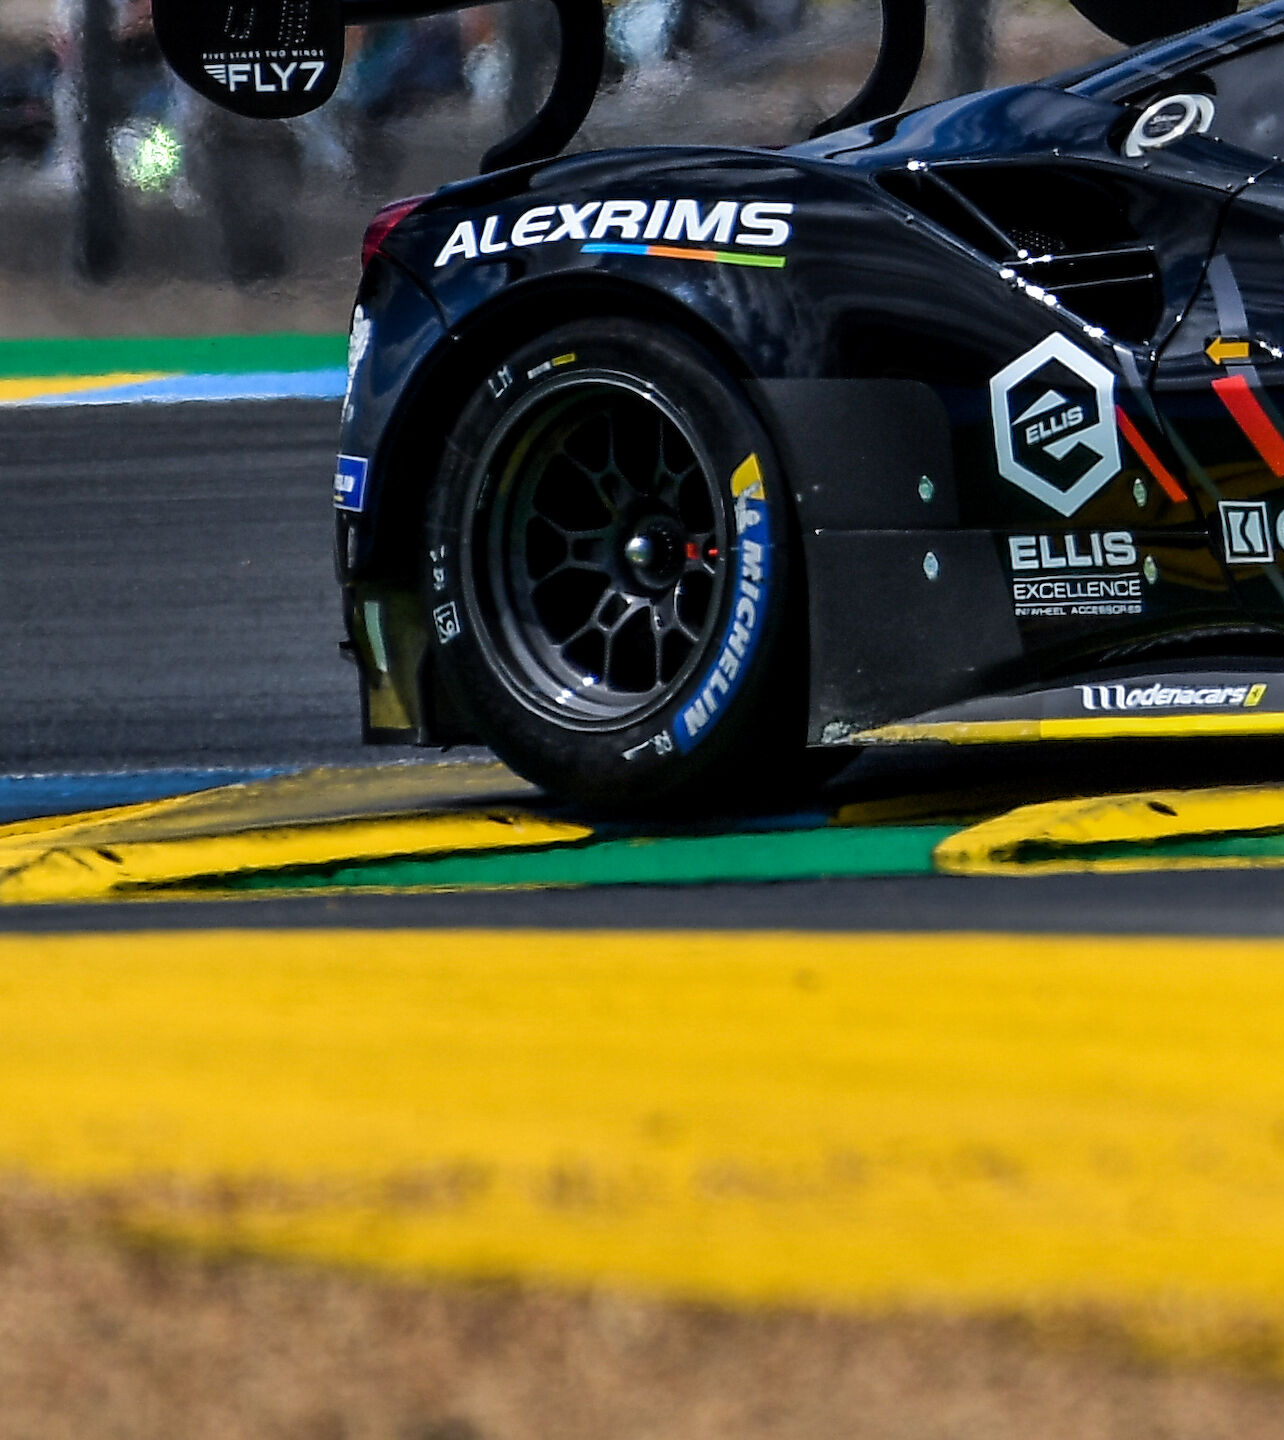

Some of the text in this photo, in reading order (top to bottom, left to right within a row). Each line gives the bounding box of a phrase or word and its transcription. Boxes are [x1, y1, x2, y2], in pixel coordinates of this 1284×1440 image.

[229, 50, 261, 60] STARS
[264, 49, 287, 58] TWO
[228, 60, 325, 92] FLY7
[434, 199, 794, 268] ALEXRIMS
[1025, 404, 1084, 446] ELLIS
[1008, 531, 1138, 571] ELLIS
[1013, 579, 1142, 601] EXCELLENCE
[683, 538, 763, 738] MICHELIN
